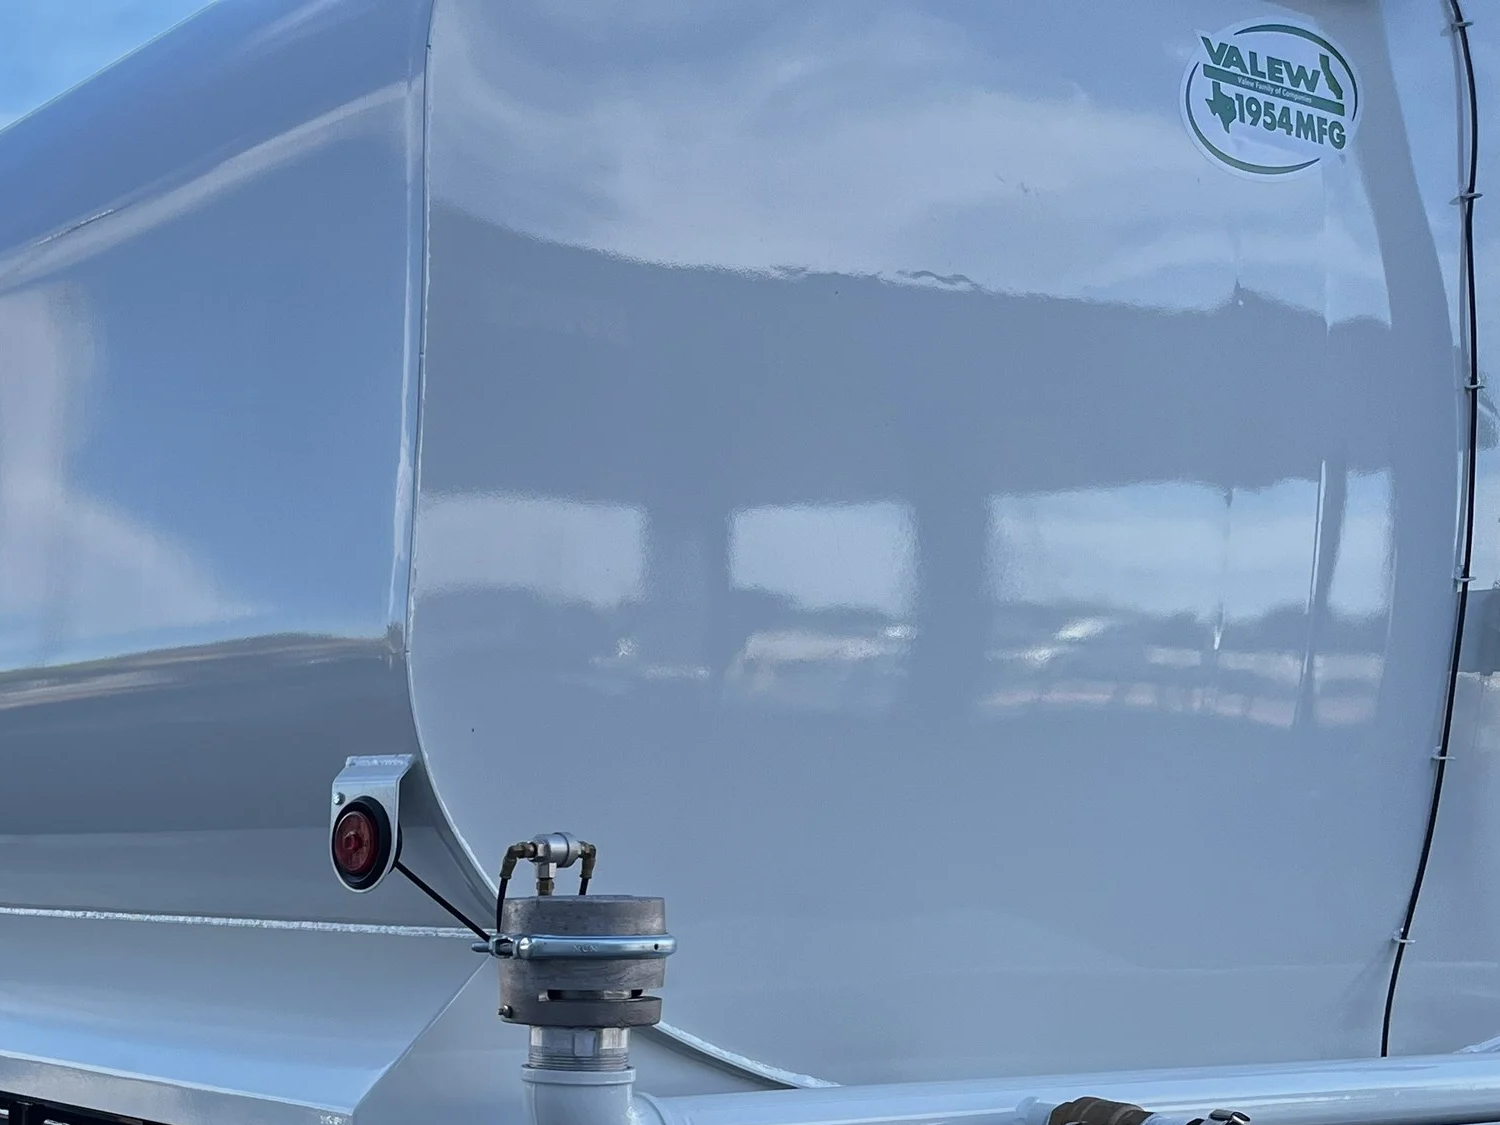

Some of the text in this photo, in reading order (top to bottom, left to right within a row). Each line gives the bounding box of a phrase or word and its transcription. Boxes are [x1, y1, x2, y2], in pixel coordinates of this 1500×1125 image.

[1201, 36, 1320, 93] VALEW
[1255, 82, 1275, 95] Family
[1282, 88, 1312, 104] Companies
[1235, 93, 1346, 150] 1954MFG
